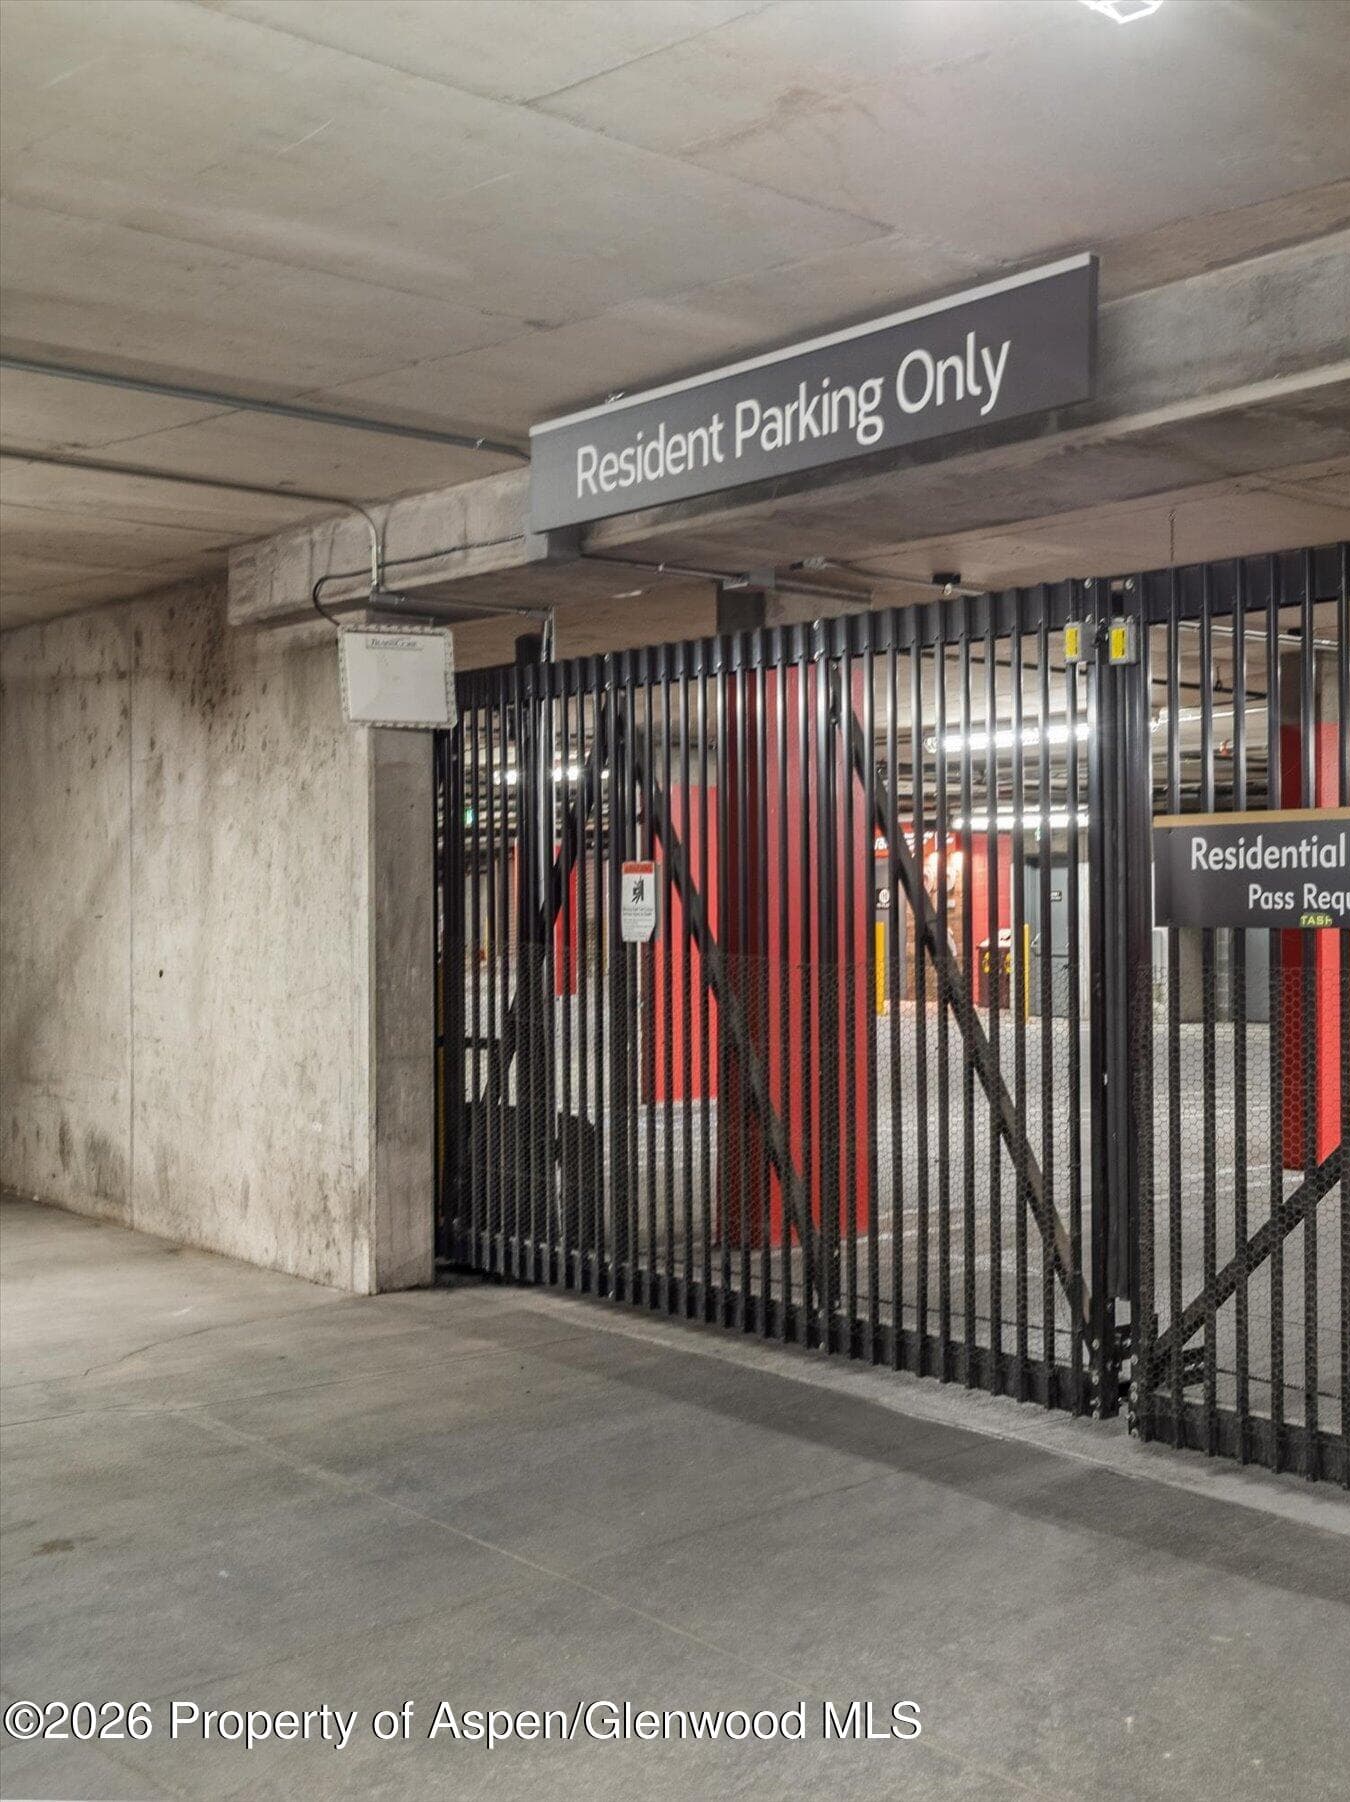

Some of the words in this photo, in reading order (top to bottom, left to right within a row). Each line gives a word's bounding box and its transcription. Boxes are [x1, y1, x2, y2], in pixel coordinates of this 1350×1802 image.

[577, 414, 724, 498] Resident
[735, 376, 884, 458] Parking
[896, 331, 1011, 415] Only
[1191, 832, 1346, 870] Residential
[1248, 883, 1294, 910] Pass
